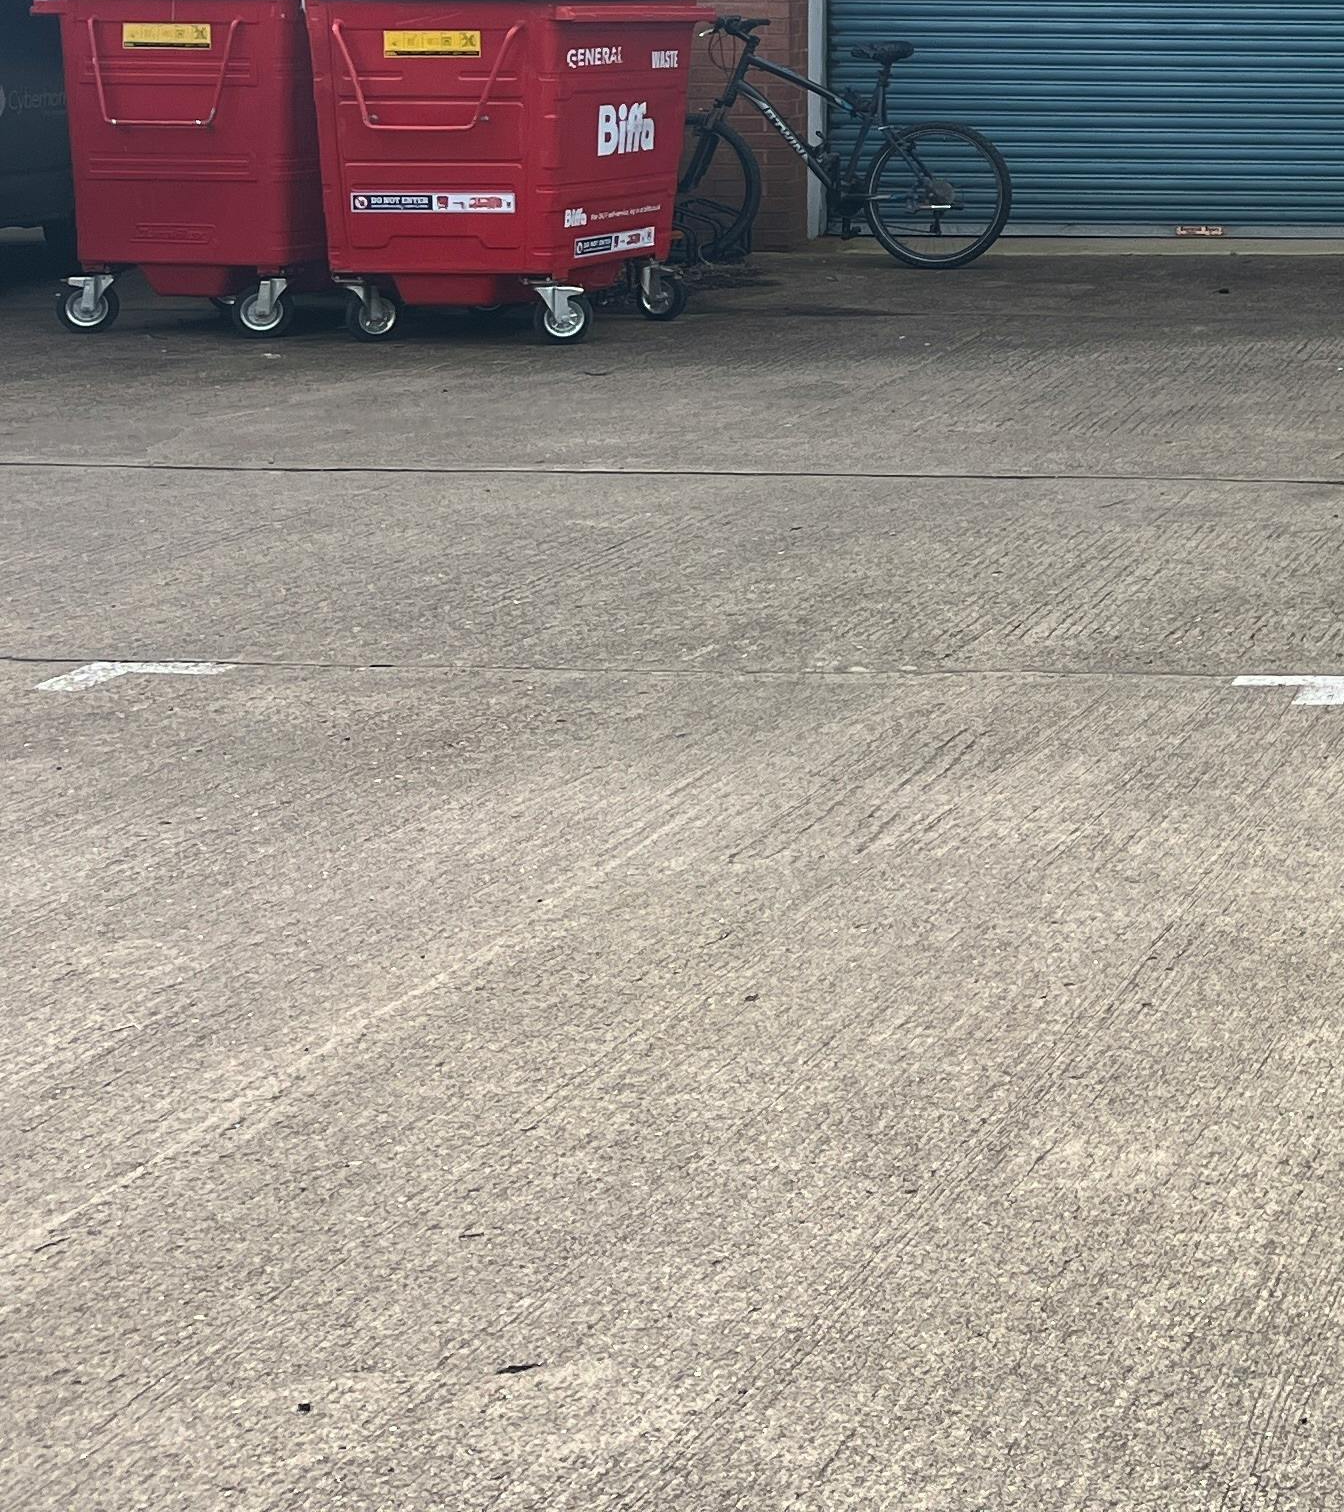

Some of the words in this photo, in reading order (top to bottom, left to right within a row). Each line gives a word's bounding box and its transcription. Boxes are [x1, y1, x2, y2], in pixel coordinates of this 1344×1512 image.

[567, 47, 623, 68] GENERAL
[651, 50, 679, 68] WASTE
[597, 101, 655, 157] Biffa
[370, 196, 383, 204] DO
[383, 196, 400, 204] NOT
[401, 196, 429, 204] ENTER
[564, 208, 587, 228] Biffa
